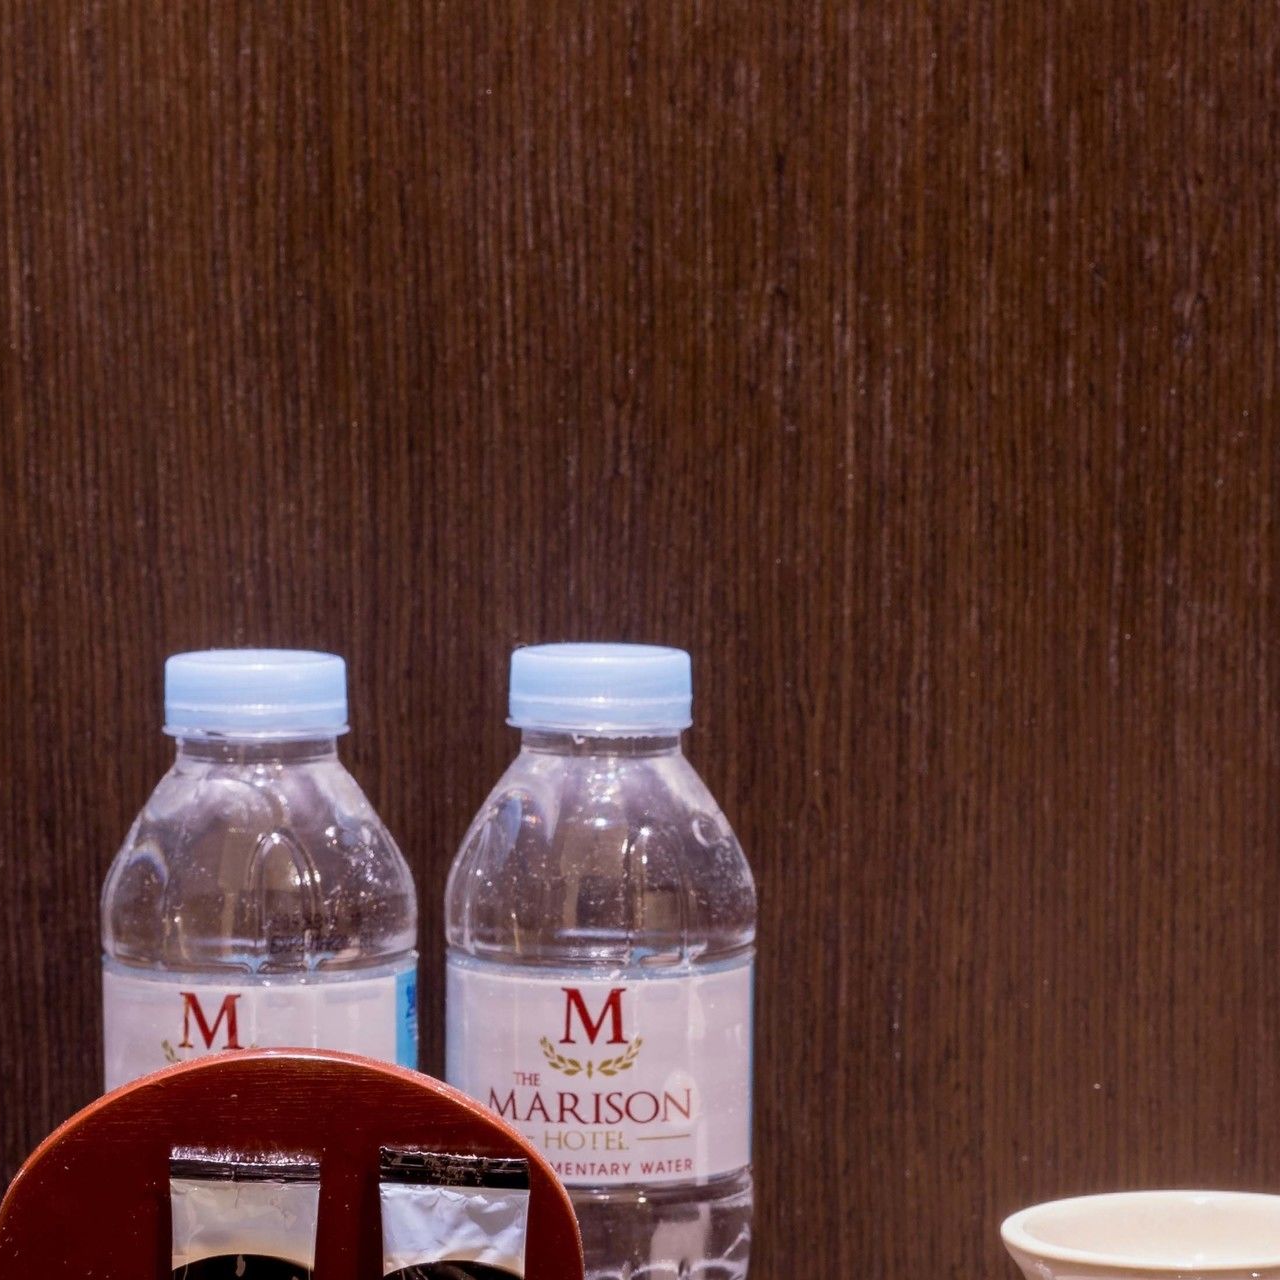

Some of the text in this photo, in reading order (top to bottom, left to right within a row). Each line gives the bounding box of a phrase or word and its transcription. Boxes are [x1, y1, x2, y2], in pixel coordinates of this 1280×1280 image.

[178, 991, 245, 1050] M
[559, 987, 629, 1045] M
[512, 1071, 542, 1087] THE
[488, 1087, 693, 1126] MARISON
[543, 1129, 630, 1152] HOTEL
[639, 1158, 694, 1175] WATER
